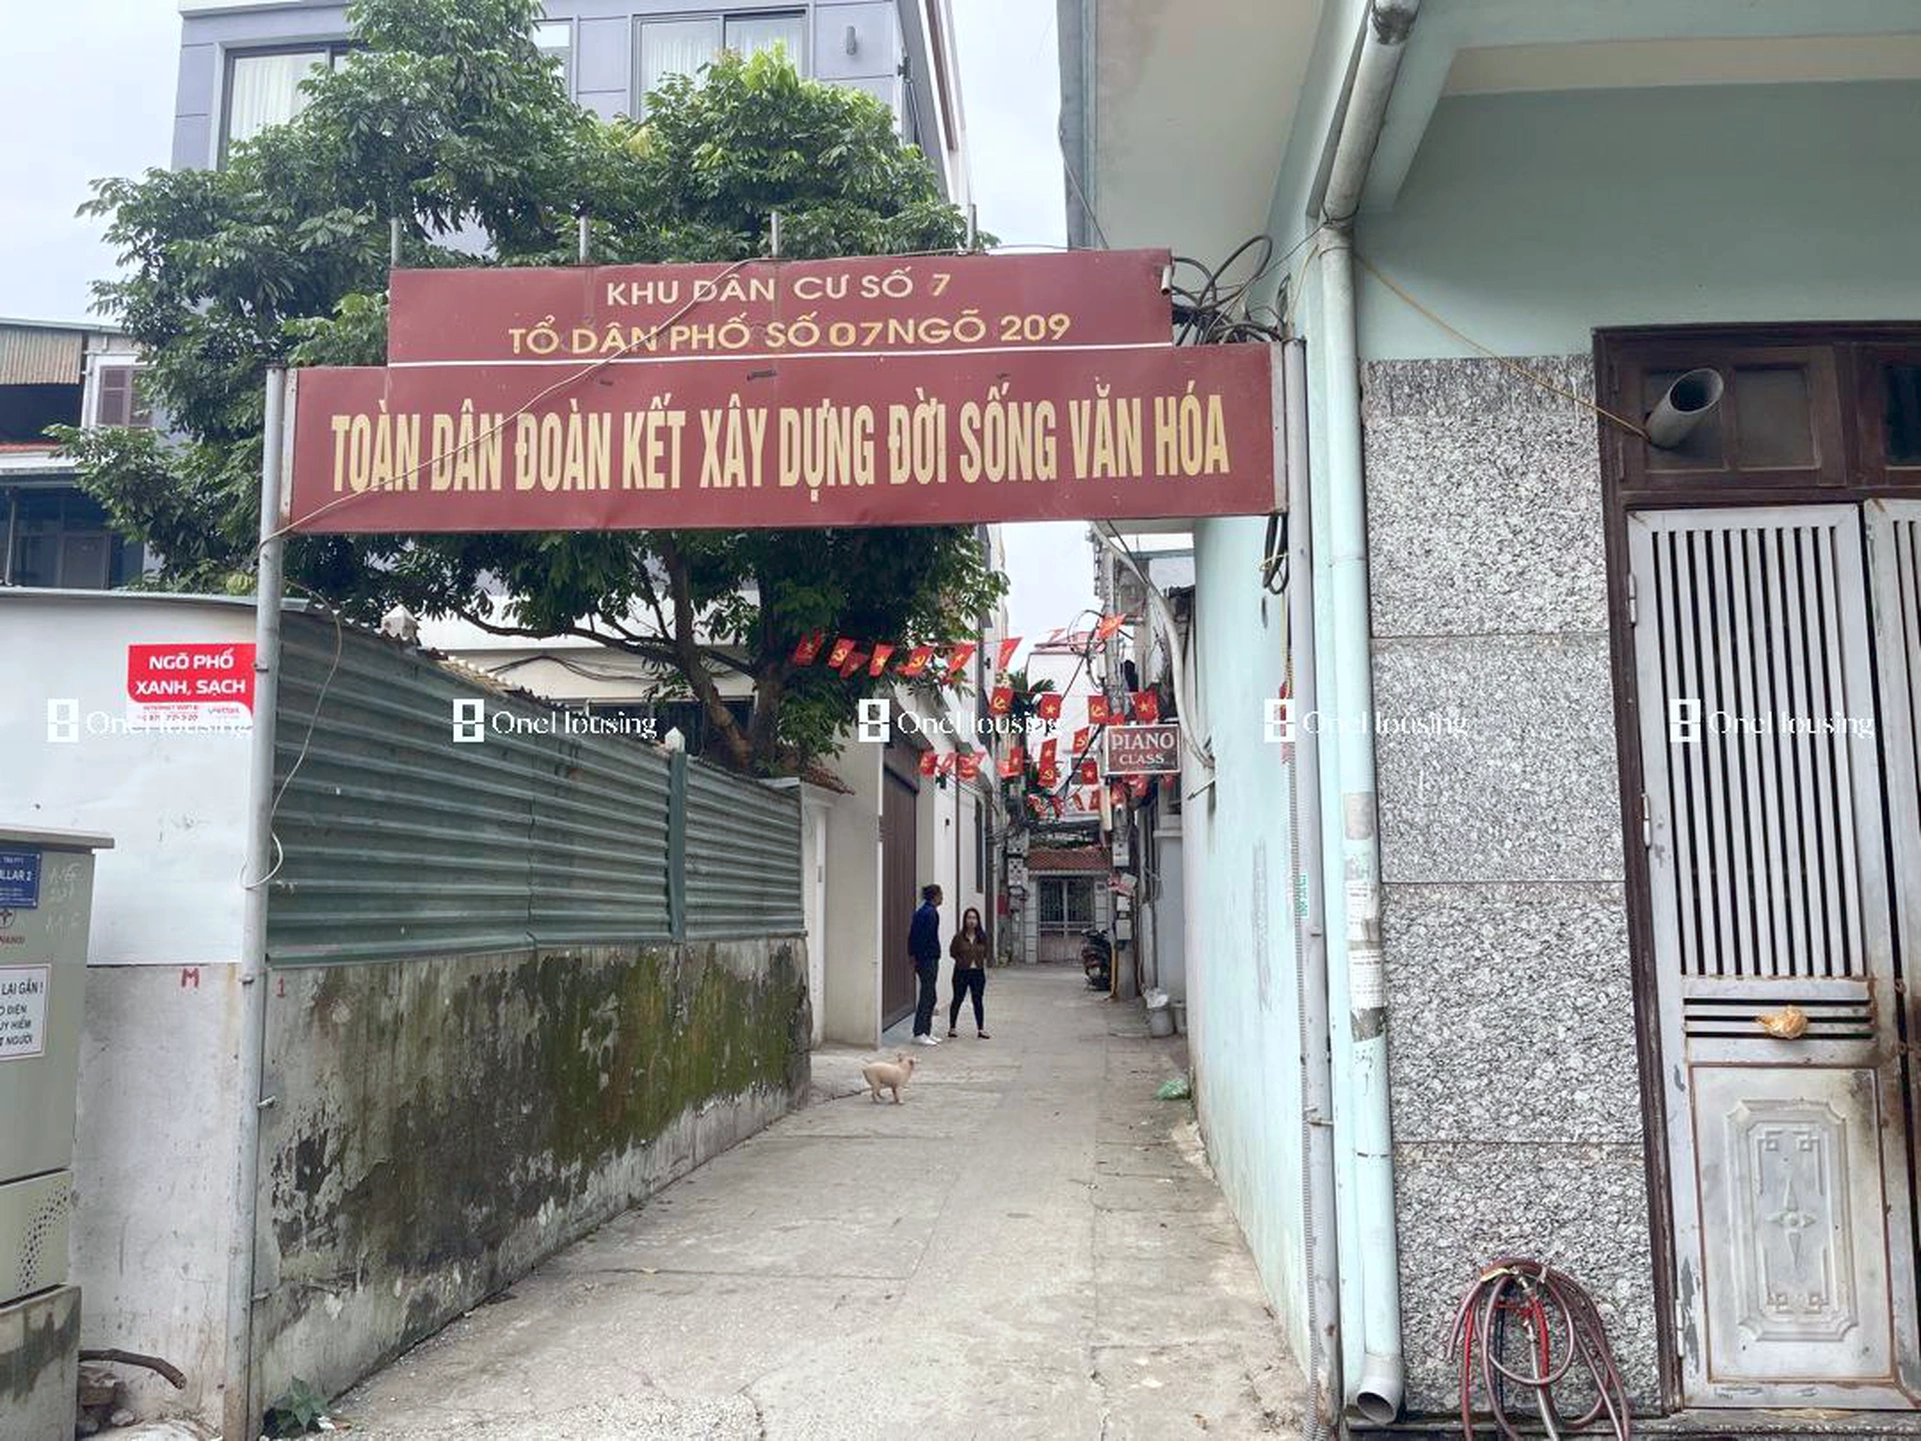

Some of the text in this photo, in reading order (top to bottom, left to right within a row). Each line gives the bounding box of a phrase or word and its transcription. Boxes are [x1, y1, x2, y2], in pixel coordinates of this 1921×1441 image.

[607, 265, 951, 306] KHU DÂN CƯ SỐ 7
[508, 314, 560, 355] TỔ
[571, 321, 659, 354] DÂN
[669, 311, 751, 352] PHỐ
[765, 311, 821, 348] SỐ
[1000, 312, 1072, 342] 209
[331, 379, 1231, 502] TOÀN DÂN ĐOÀN KẾT XÂY DỰNG ĐỜI SỐNG VĂN HÓA
[149, 647, 235, 670] NGÕ PHỐ
[135, 679, 247, 697] XANH, SẠCH
[1111, 731, 1175, 751] PIANO
[1119, 753, 1166, 765] CLASS
